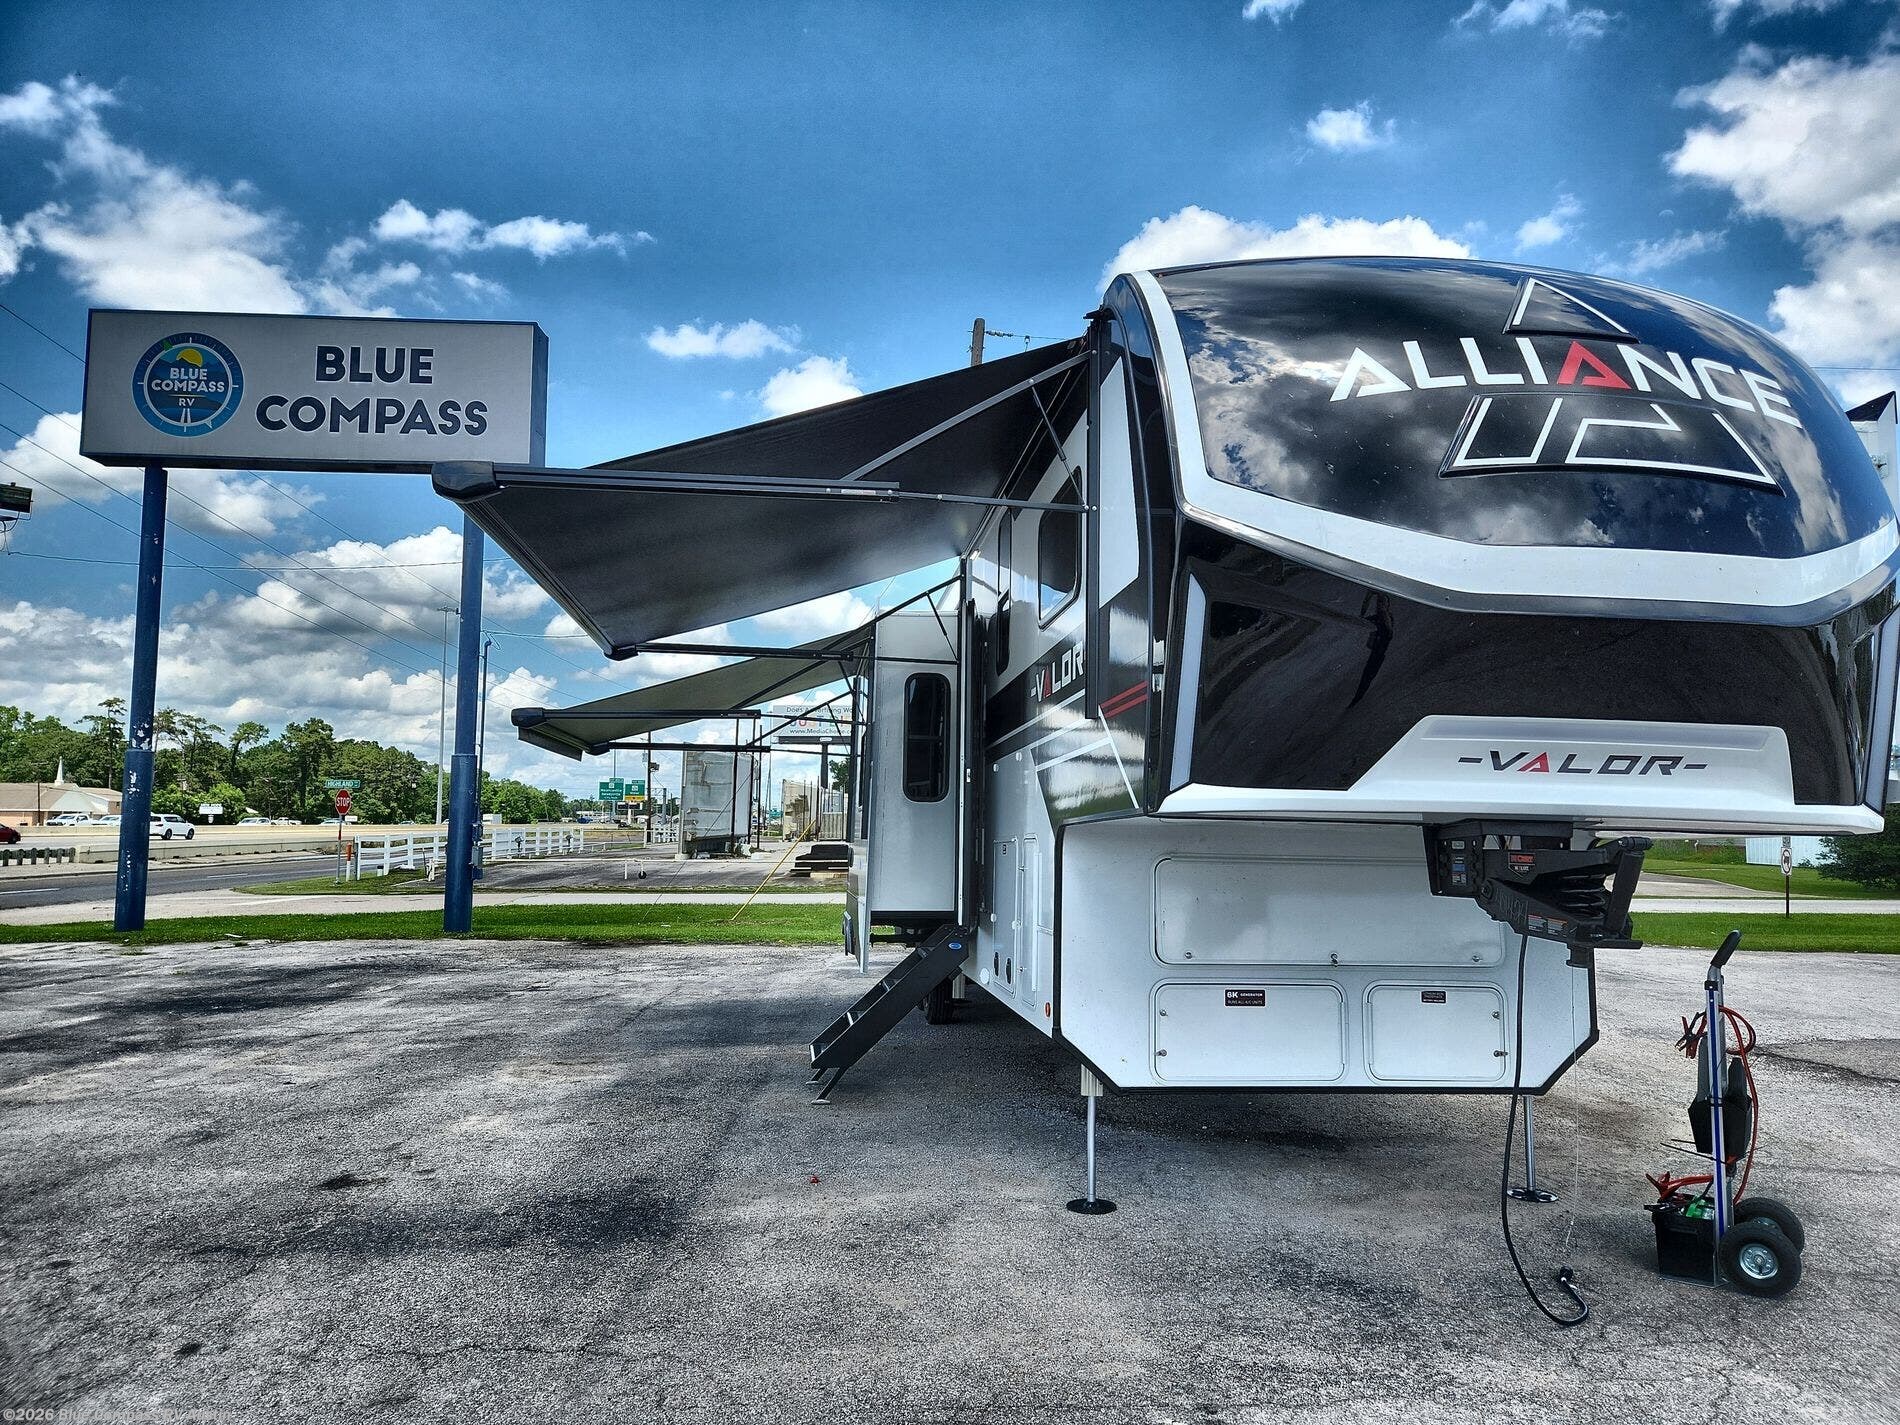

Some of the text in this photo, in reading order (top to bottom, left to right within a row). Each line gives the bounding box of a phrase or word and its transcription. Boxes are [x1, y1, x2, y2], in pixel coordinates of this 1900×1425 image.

[315, 346, 434, 384] BLUE
[170, 368, 208, 380] BLUE
[151, 380, 225, 393] COMPASS
[1330, 337, 1803, 429] ALLIANCE
[179, 398, 195, 407] RV
[256, 395, 488, 436] COMPASS
[336, 797, 350, 807] STOP
